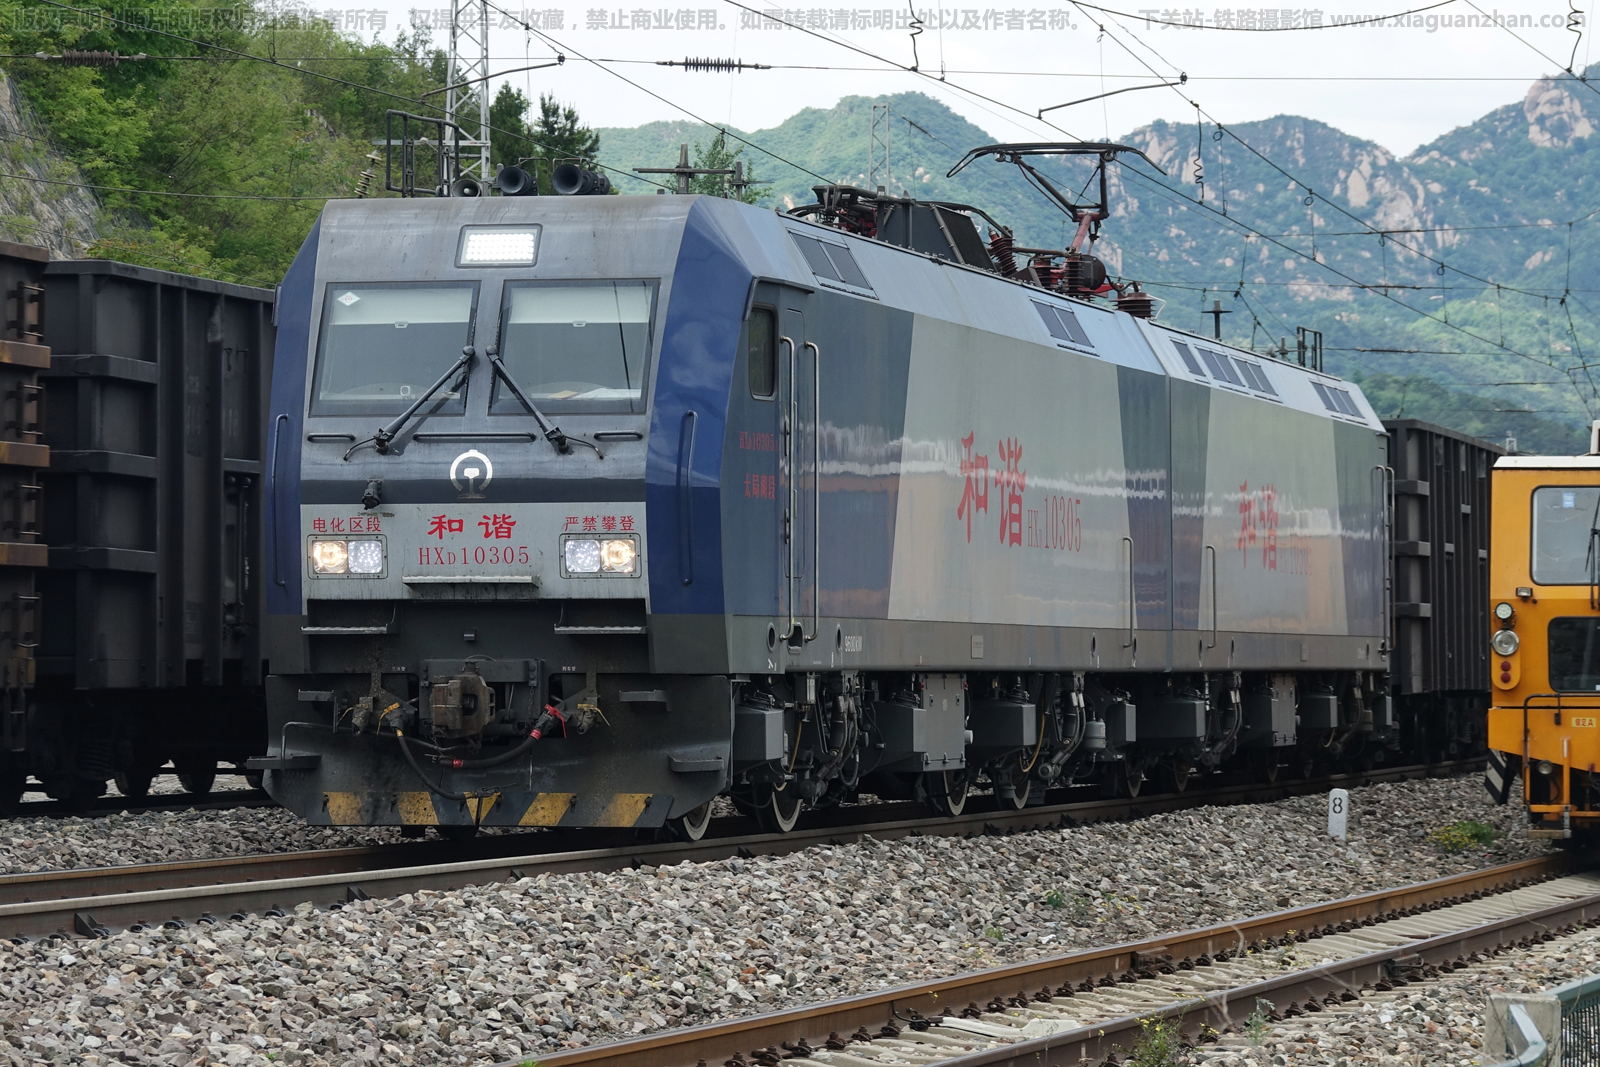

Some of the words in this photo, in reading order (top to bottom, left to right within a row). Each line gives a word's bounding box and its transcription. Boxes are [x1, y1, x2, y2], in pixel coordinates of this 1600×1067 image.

[957, 430, 1026, 548] 和谐
[312, 516, 381, 532] 电化区段
[427, 514, 517, 540] 和谐
[564, 515, 635, 531] 严禁攀登
[1238, 479, 1278, 572] 和谐
[418, 546, 530, 565] HXD10305
[1332, 797, 1343, 814] 8
